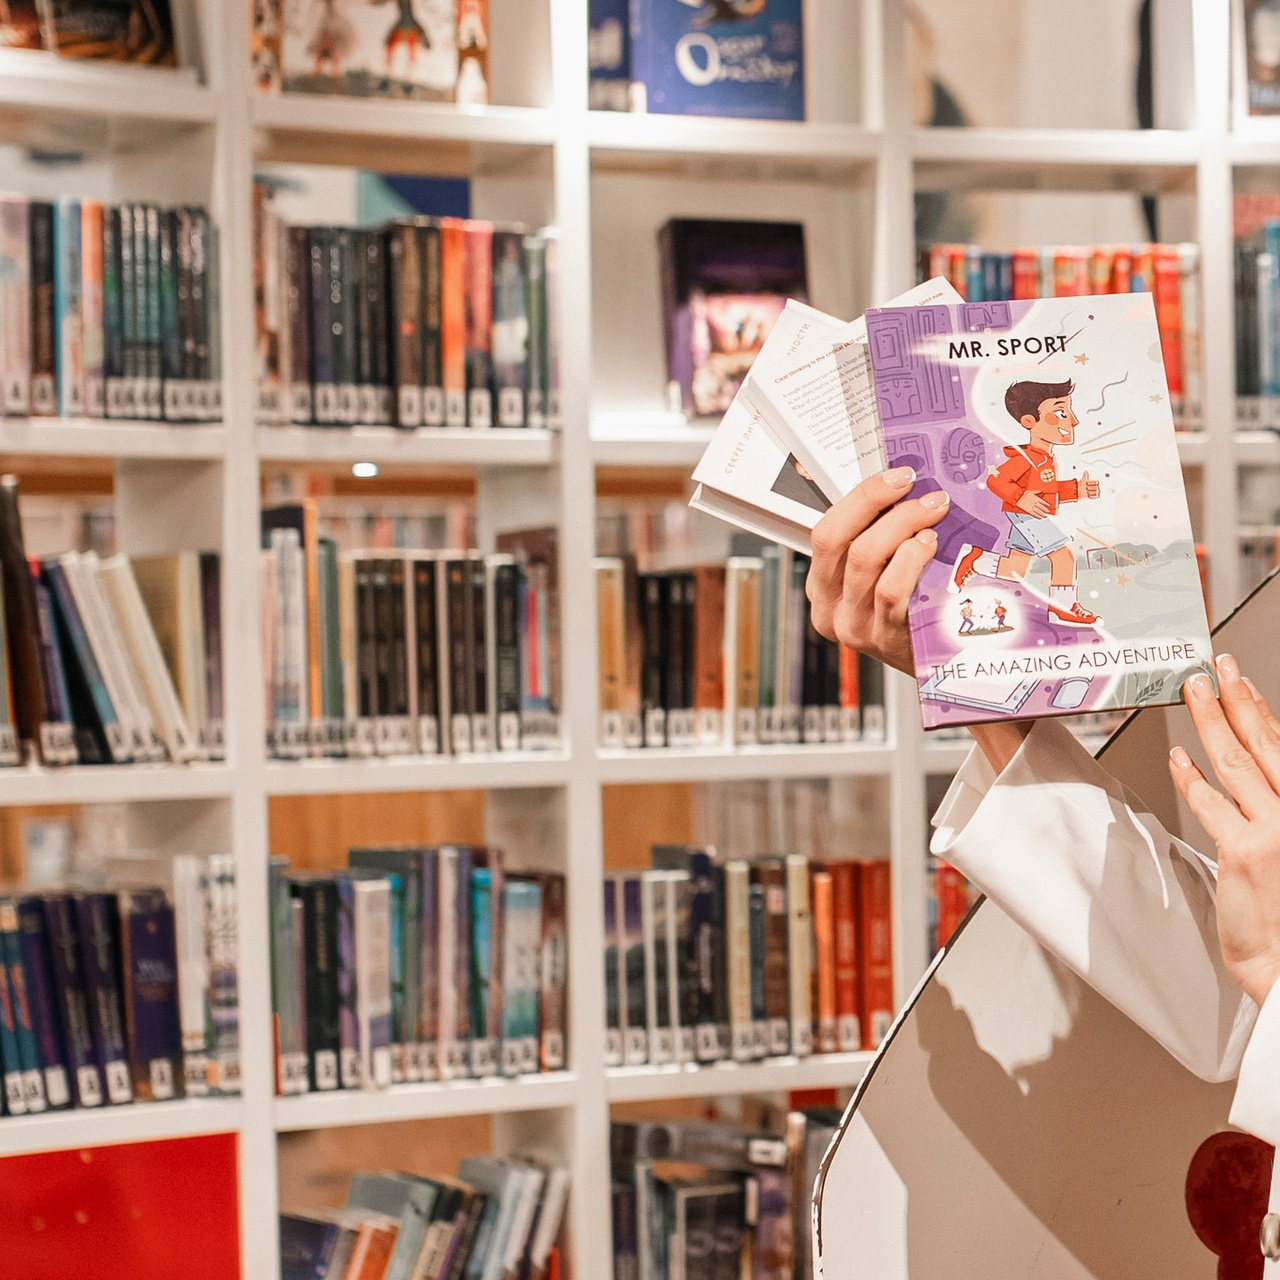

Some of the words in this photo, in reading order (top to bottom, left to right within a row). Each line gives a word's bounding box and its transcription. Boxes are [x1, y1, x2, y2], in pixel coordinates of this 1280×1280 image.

[948, 341, 990, 359] MR.
[997, 335, 1067, 356] SPORT
[774, 374, 789, 384] Clear
[789, 363, 811, 378] thinking
[816, 354, 825, 362] the
[825, 345, 844, 357] critical
[802, 379, 820, 389] moment
[793, 403, 806, 412] What
[724, 442, 746, 475] СЕКРЕТ
[931, 662, 967, 680] THE
[974, 654, 1072, 678] AMAZING
[1078, 643, 1196, 668] ADVENTURE
